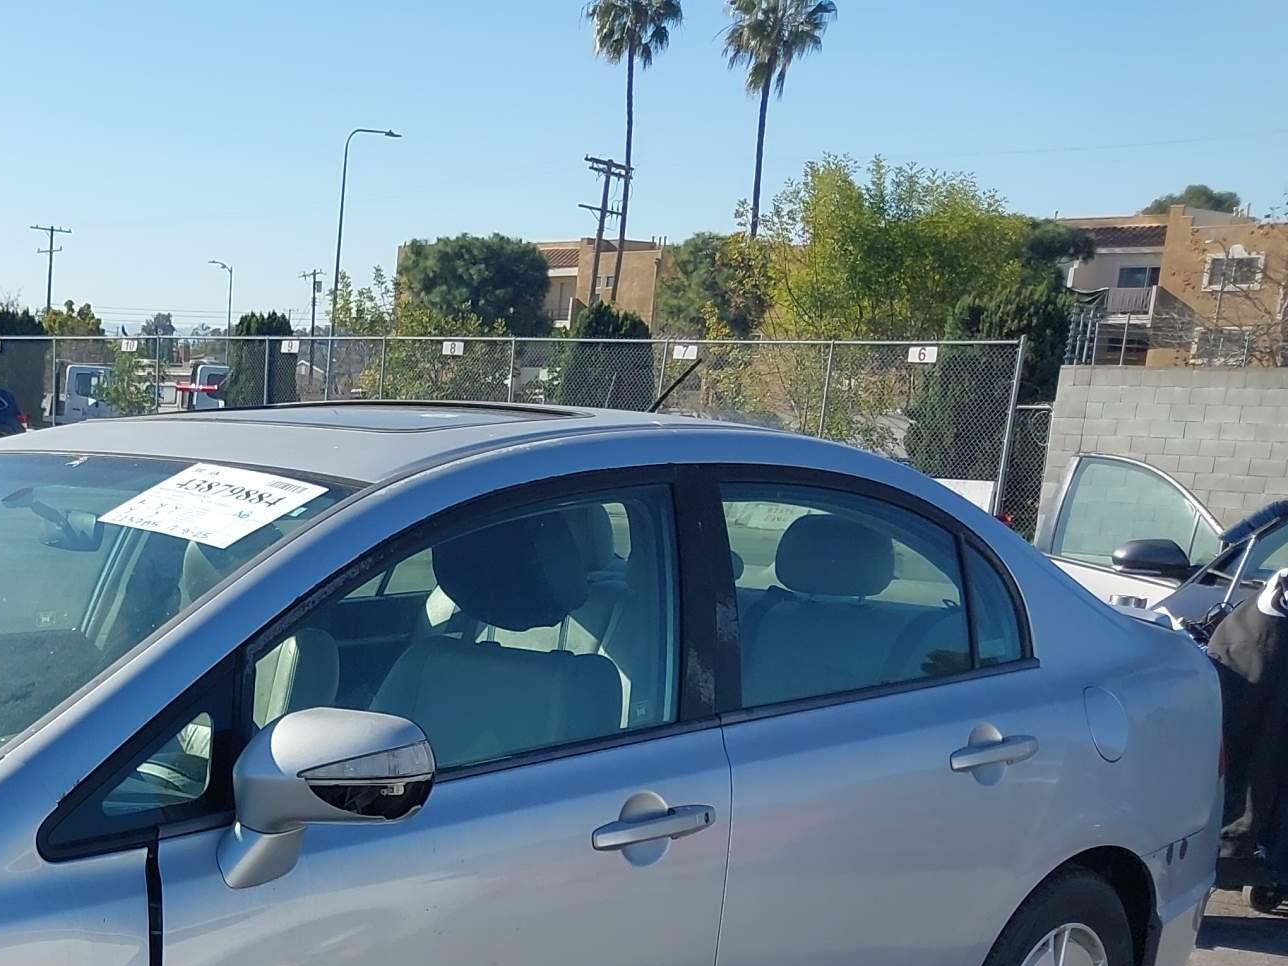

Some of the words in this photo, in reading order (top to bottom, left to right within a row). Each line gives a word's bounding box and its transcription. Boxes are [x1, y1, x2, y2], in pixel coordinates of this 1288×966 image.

[125, 341, 134, 351] 10
[287, 341, 293, 351] 9
[450, 343, 456, 353] 8
[681, 345, 689, 357] 7
[918, 348, 926, 361] 6
[176, 478, 287, 507] 43879884
